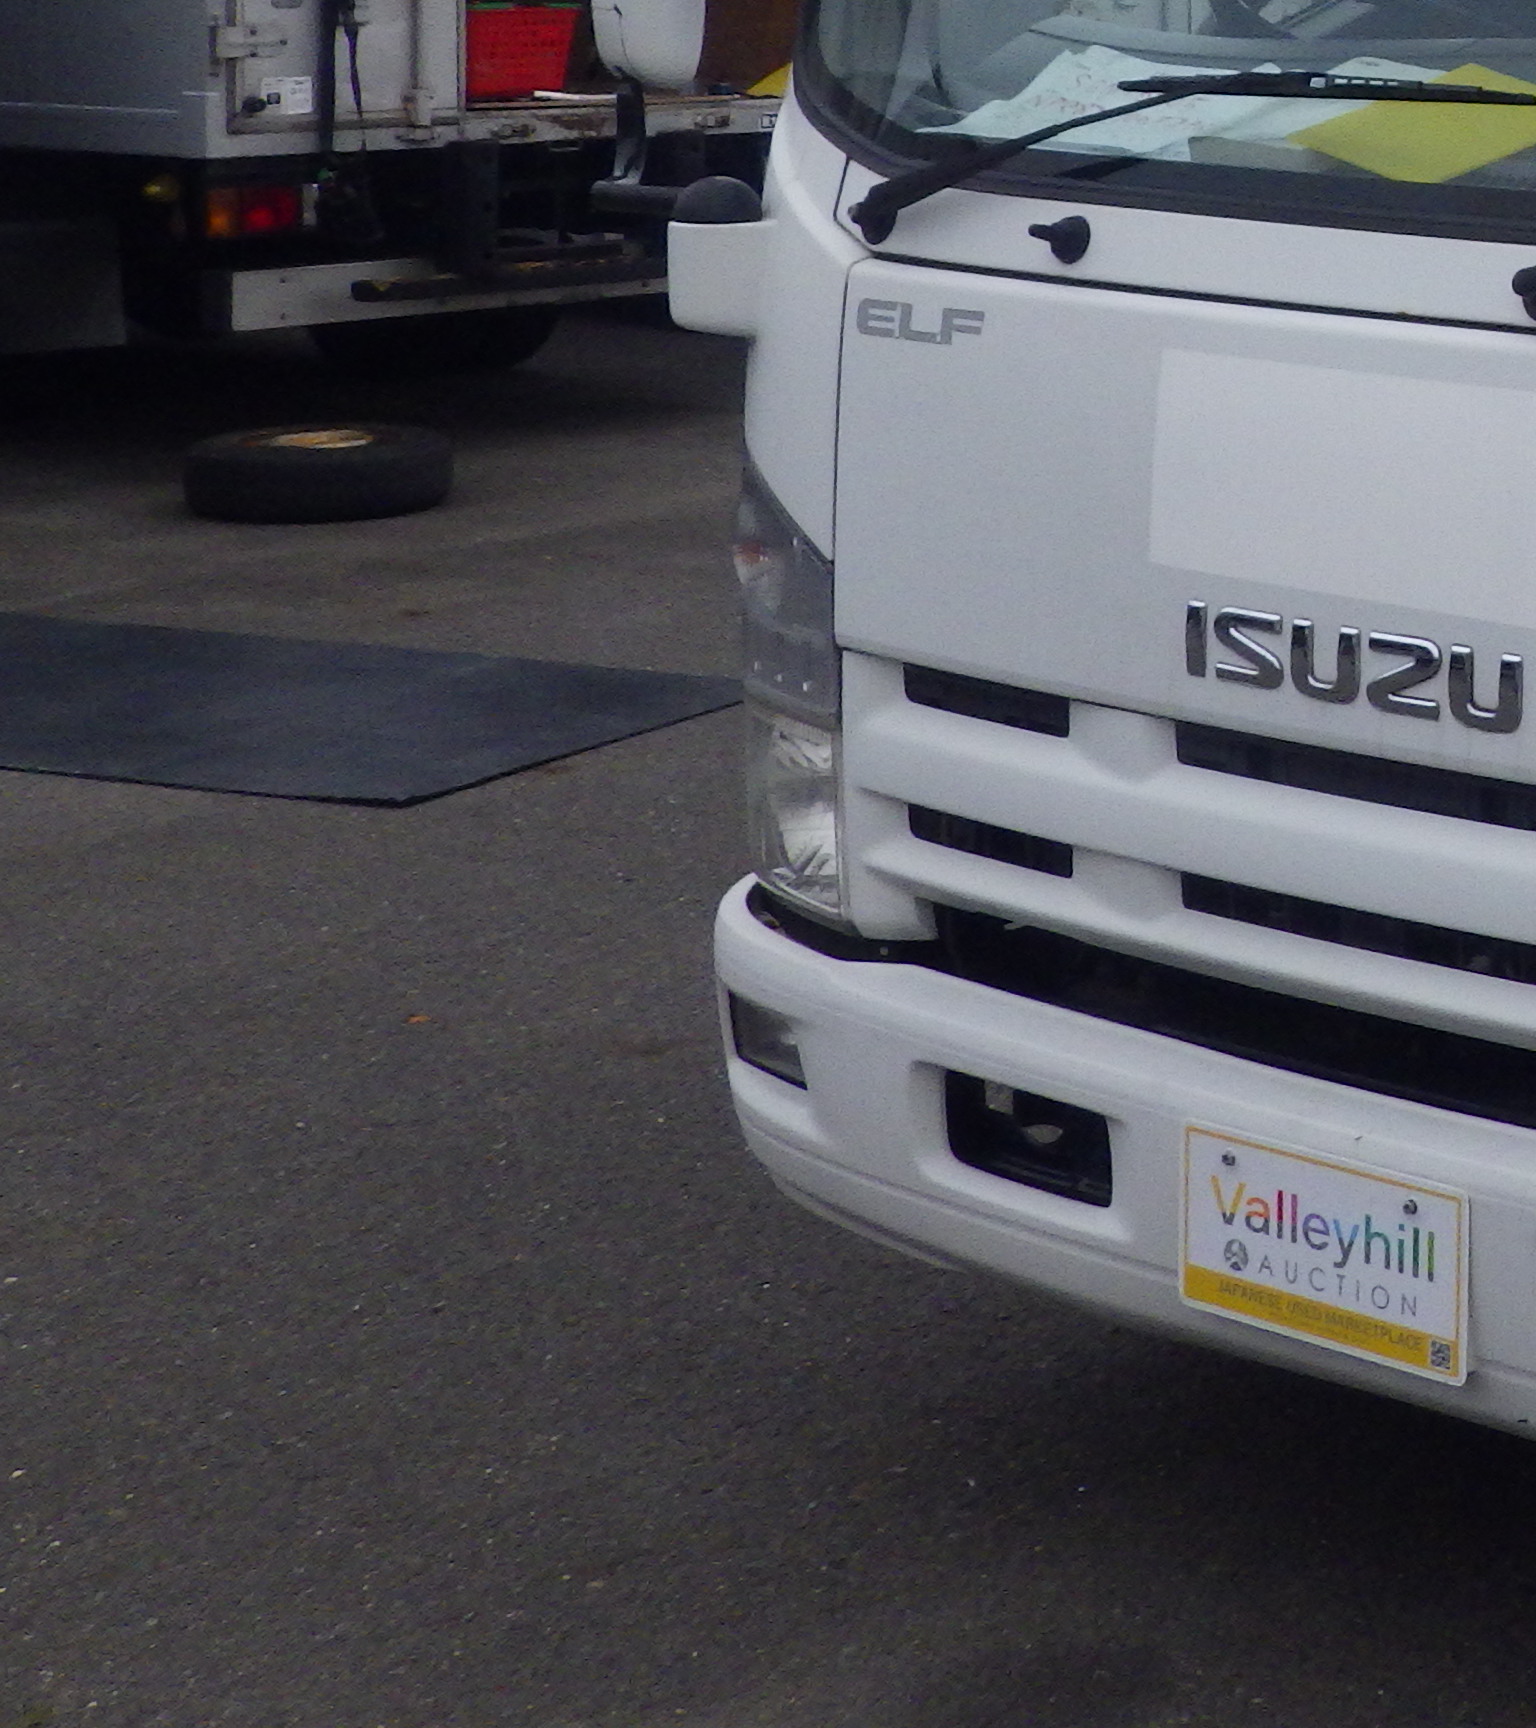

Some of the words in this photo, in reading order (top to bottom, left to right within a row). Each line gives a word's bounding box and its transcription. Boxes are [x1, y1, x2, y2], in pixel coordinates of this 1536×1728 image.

[855, 297, 985, 345] ELF
[1184, 599, 1525, 734] ISUZU
[1209, 1174, 1435, 1283] Valleyhill
[1257, 1254, 1418, 1318] AUCTION
